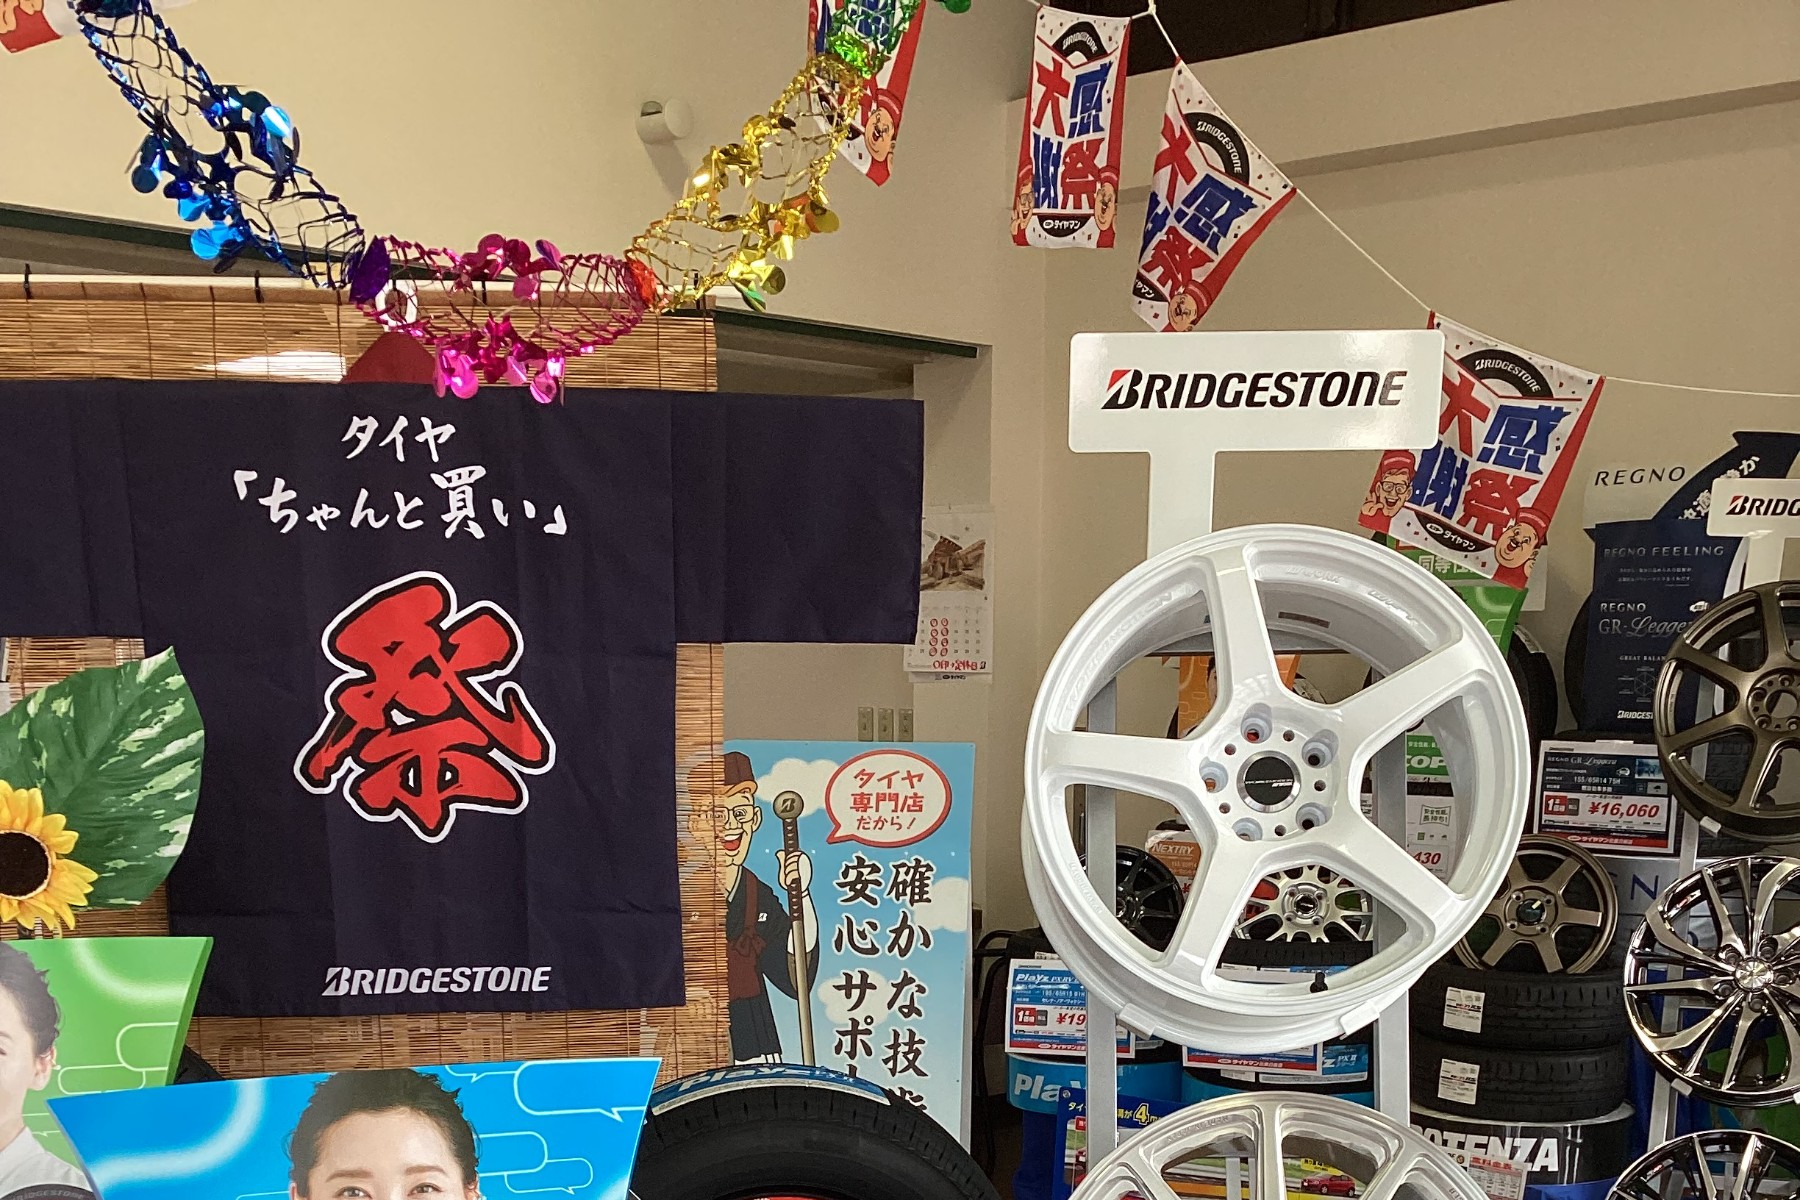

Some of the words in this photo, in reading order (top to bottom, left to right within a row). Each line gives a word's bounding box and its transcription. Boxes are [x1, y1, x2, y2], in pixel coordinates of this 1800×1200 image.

[1196, 120, 1243, 175] BRIDGESTONE
[1474, 357, 1542, 393] BRIDGESTONE
[1101, 368, 1408, 411] BRIDGESTONE
[340, 415, 457, 462] タイヤ
[1594, 466, 1686, 487] REGNO
[233, 465, 568, 539] 「ちゃんと買い」
[1443, 530, 1477, 551] タイヤマン
[1651, 546, 1725, 557] FEELING
[1600, 602, 1646, 613] REGNO
[294, 571, 556, 843] 祭
[853, 768, 925, 790] タイヤ
[850, 791, 925, 814] 専門店
[1588, 801, 1660, 819] ¥16,060
[1151, 843, 1194, 855] NEXTRY
[321, 966, 552, 996] BRIDGESTONE
[1068, 1101, 1087, 1111] タイ
